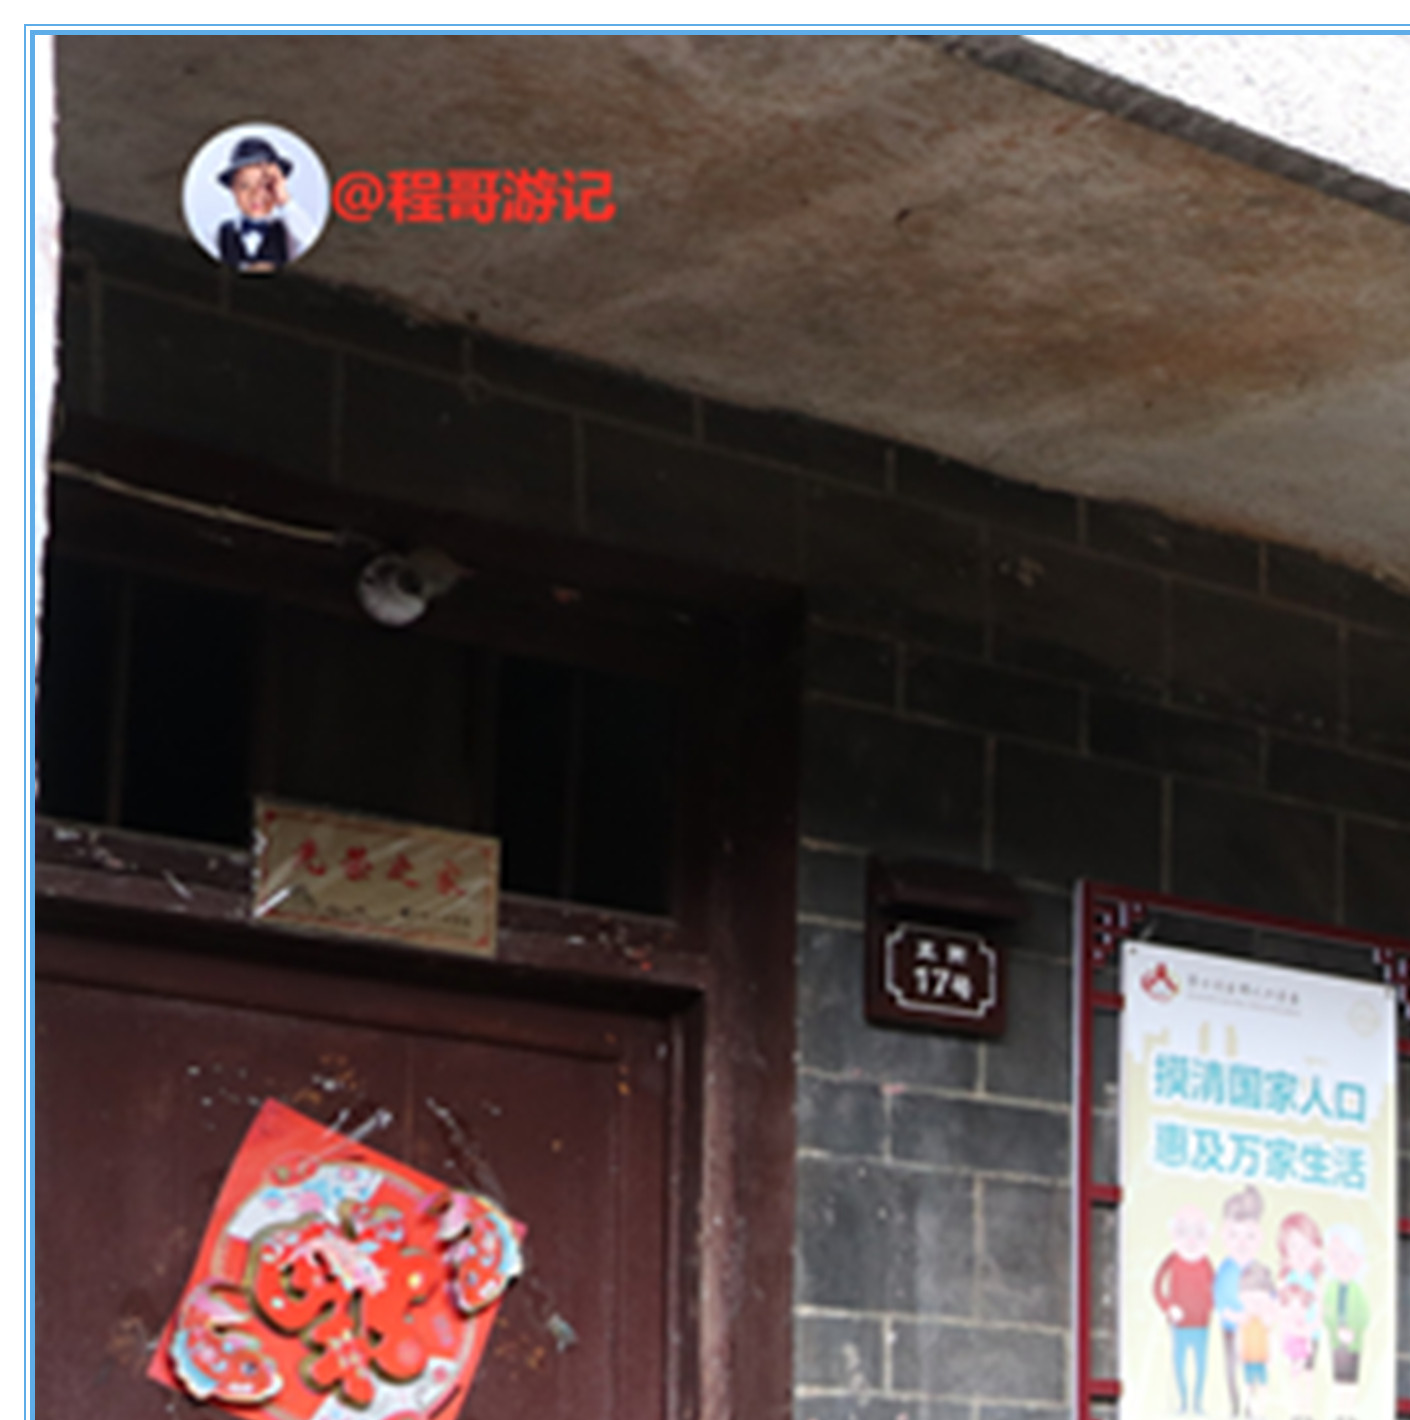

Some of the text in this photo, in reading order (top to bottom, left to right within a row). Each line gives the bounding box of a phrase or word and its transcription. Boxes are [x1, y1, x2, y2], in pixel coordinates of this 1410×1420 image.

[1154, 1052, 1368, 1124] 摸清国家人口
[1154, 1122, 1368, 1192] 惠及万家生活
